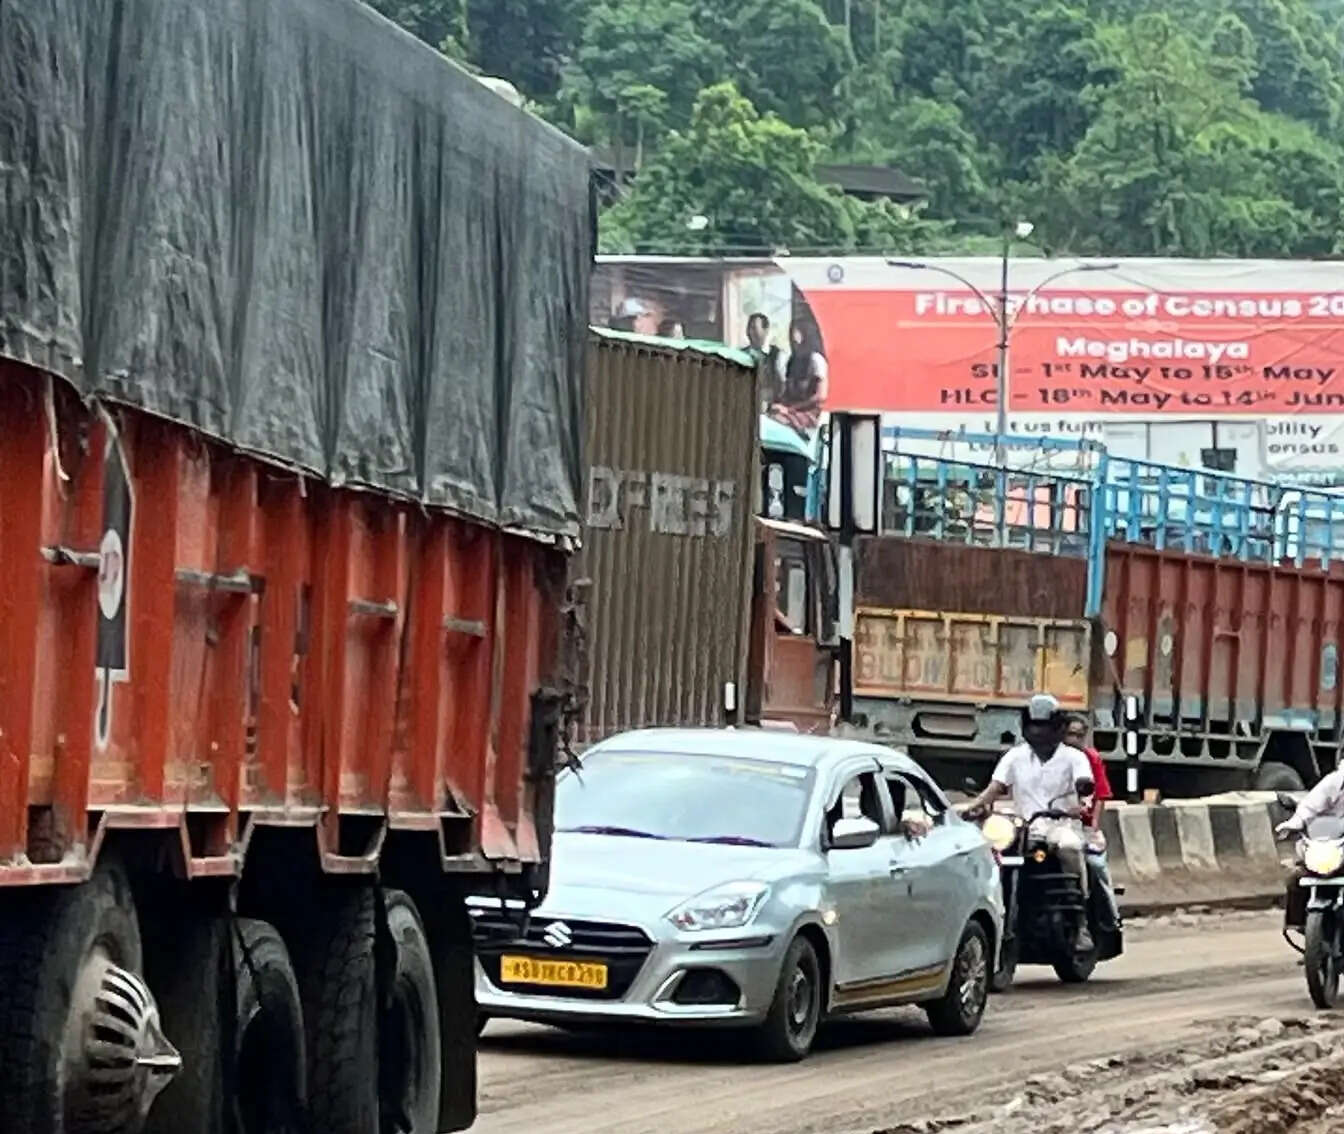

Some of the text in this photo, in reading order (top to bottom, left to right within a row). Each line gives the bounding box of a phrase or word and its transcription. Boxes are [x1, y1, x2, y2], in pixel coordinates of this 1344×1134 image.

[915, 294, 998, 316] First
[1002, 294, 1116, 316] Phase
[1121, 293, 1160, 316] of
[1165, 295, 1302, 317] Census
[1055, 337, 1249, 364] Meghalaya
[1079, 363, 1151, 383] May
[1161, 366, 1193, 380] to
[1263, 366, 1336, 386] May
[1100, 389, 1172, 410] May
[1181, 391, 1211, 406] to
[1267, 443, 1339, 454] ensus
